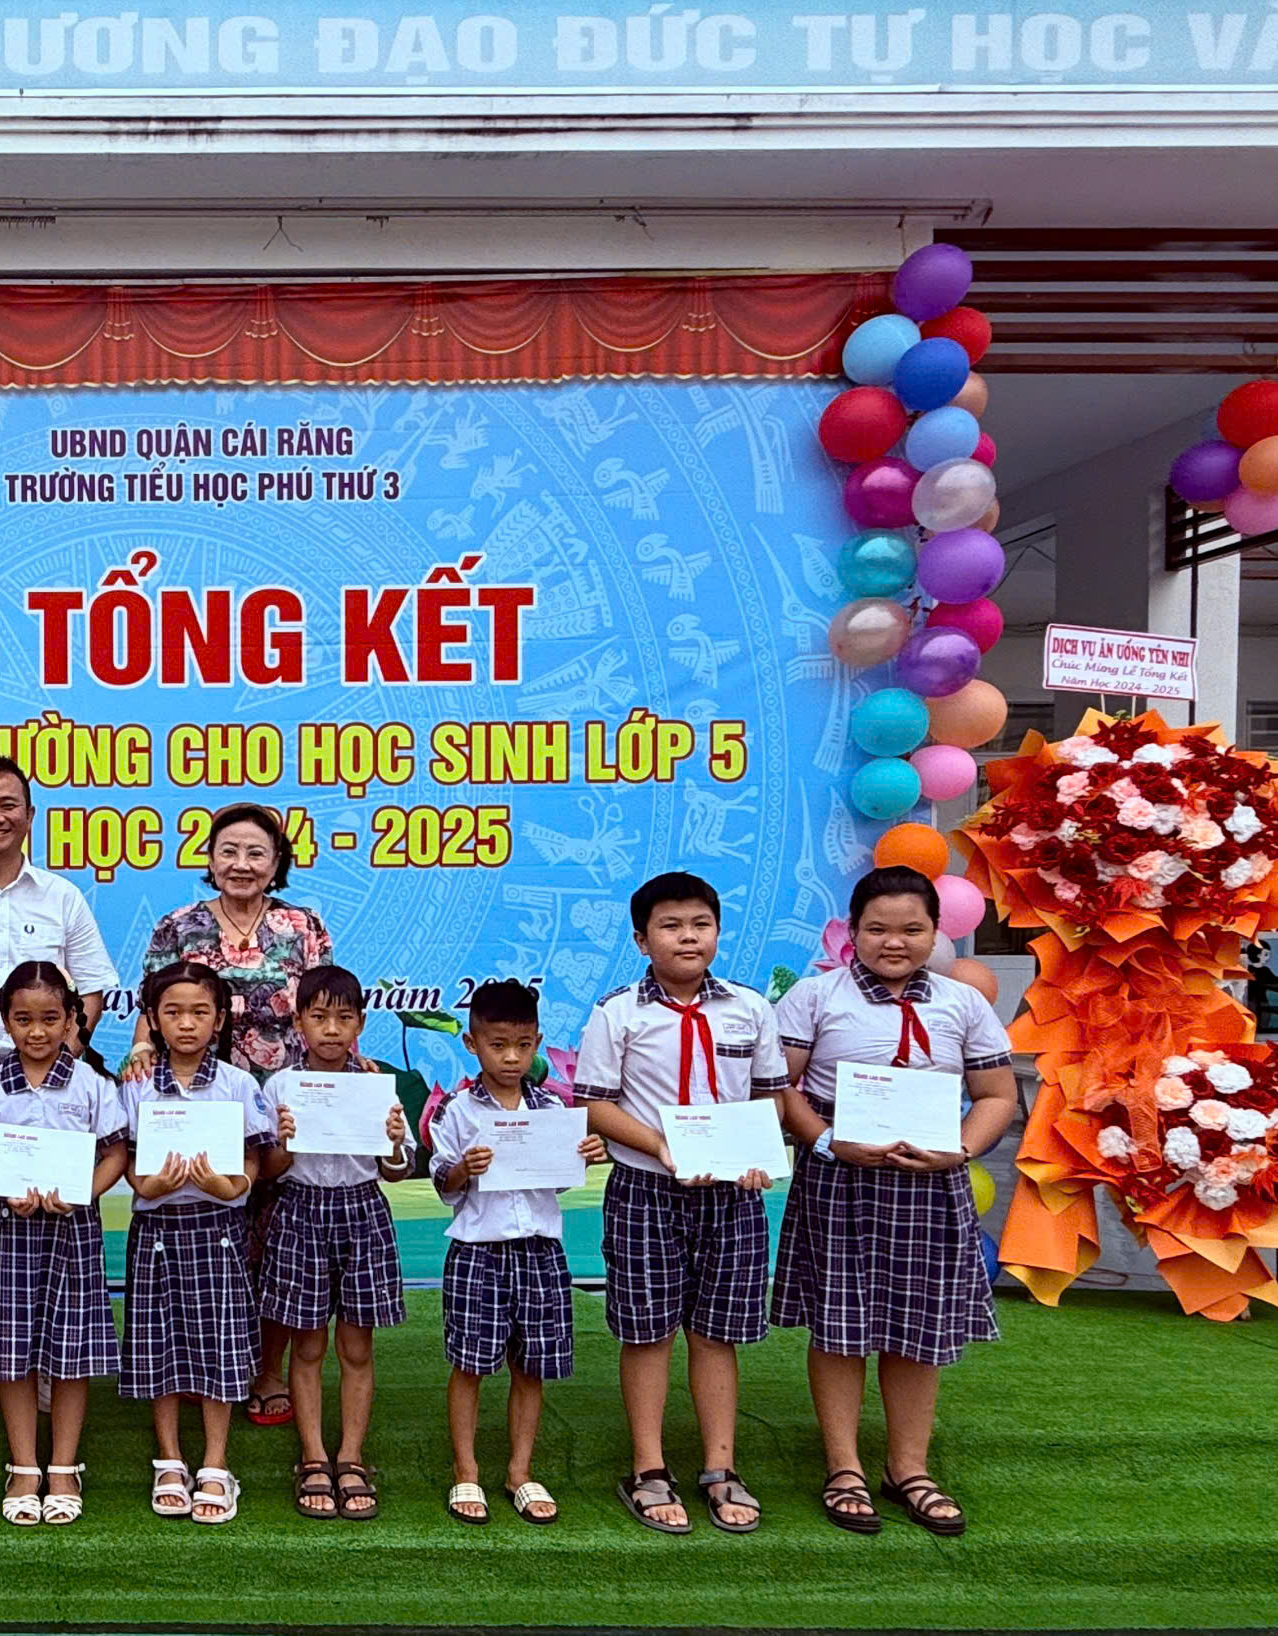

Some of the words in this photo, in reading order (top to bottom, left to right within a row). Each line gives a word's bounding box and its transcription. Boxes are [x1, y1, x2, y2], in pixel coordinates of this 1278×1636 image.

[313, 15, 518, 85] ĐẠO
[552, 3, 757, 73] ĐỨC
[792, 8, 926, 83] TỰ
[950, 12, 1151, 83] HỌC
[50, 428, 127, 458] UBND
[136, 422, 212, 464] QUẬN
[221, 420, 267, 458] CÁI
[277, 420, 354, 457] RĂNG
[5, 467, 115, 503] TRƯỜNG
[124, 461, 184, 503] TIỂU
[192, 472, 249, 508] HỌC
[257, 465, 313, 501] PHÚ
[321, 463, 381, 501] THỨ
[382, 470, 401, 501] 3
[26, 550, 305, 686] TỔNG
[340, 553, 536, 684] KẾT
[1051, 658, 1082, 671] Chúc
[1140, 666, 1166, 680] Tổng
[1169, 671, 1188, 682] Kết
[1052, 637, 1078, 659] DỊCH
[1081, 640, 1096, 661] VỤ
[1116, 638, 1147, 662] UỐNG
[1171, 651, 1190, 668] NHI
[1061, 675, 1087, 686] Năm
[1090, 677, 1110, 688] Học
[1113, 681, 1142, 692] 2024
[1151, 684, 1181, 695] 2025
[167, 723, 283, 786] CHO
[298, 722, 415, 798] HỌC
[430, 721, 570, 786] SINH
[585, 708, 694, 783] LỚP
[708, 720, 747, 784] 5
[46, 807, 163, 883] HỌC
[177, 806, 319, 868] 24
[330, 822, 357, 850] -
[370, 805, 511, 869] 2025
[363, 977, 442, 1010] năm
[454, 977, 543, 1010] 25
